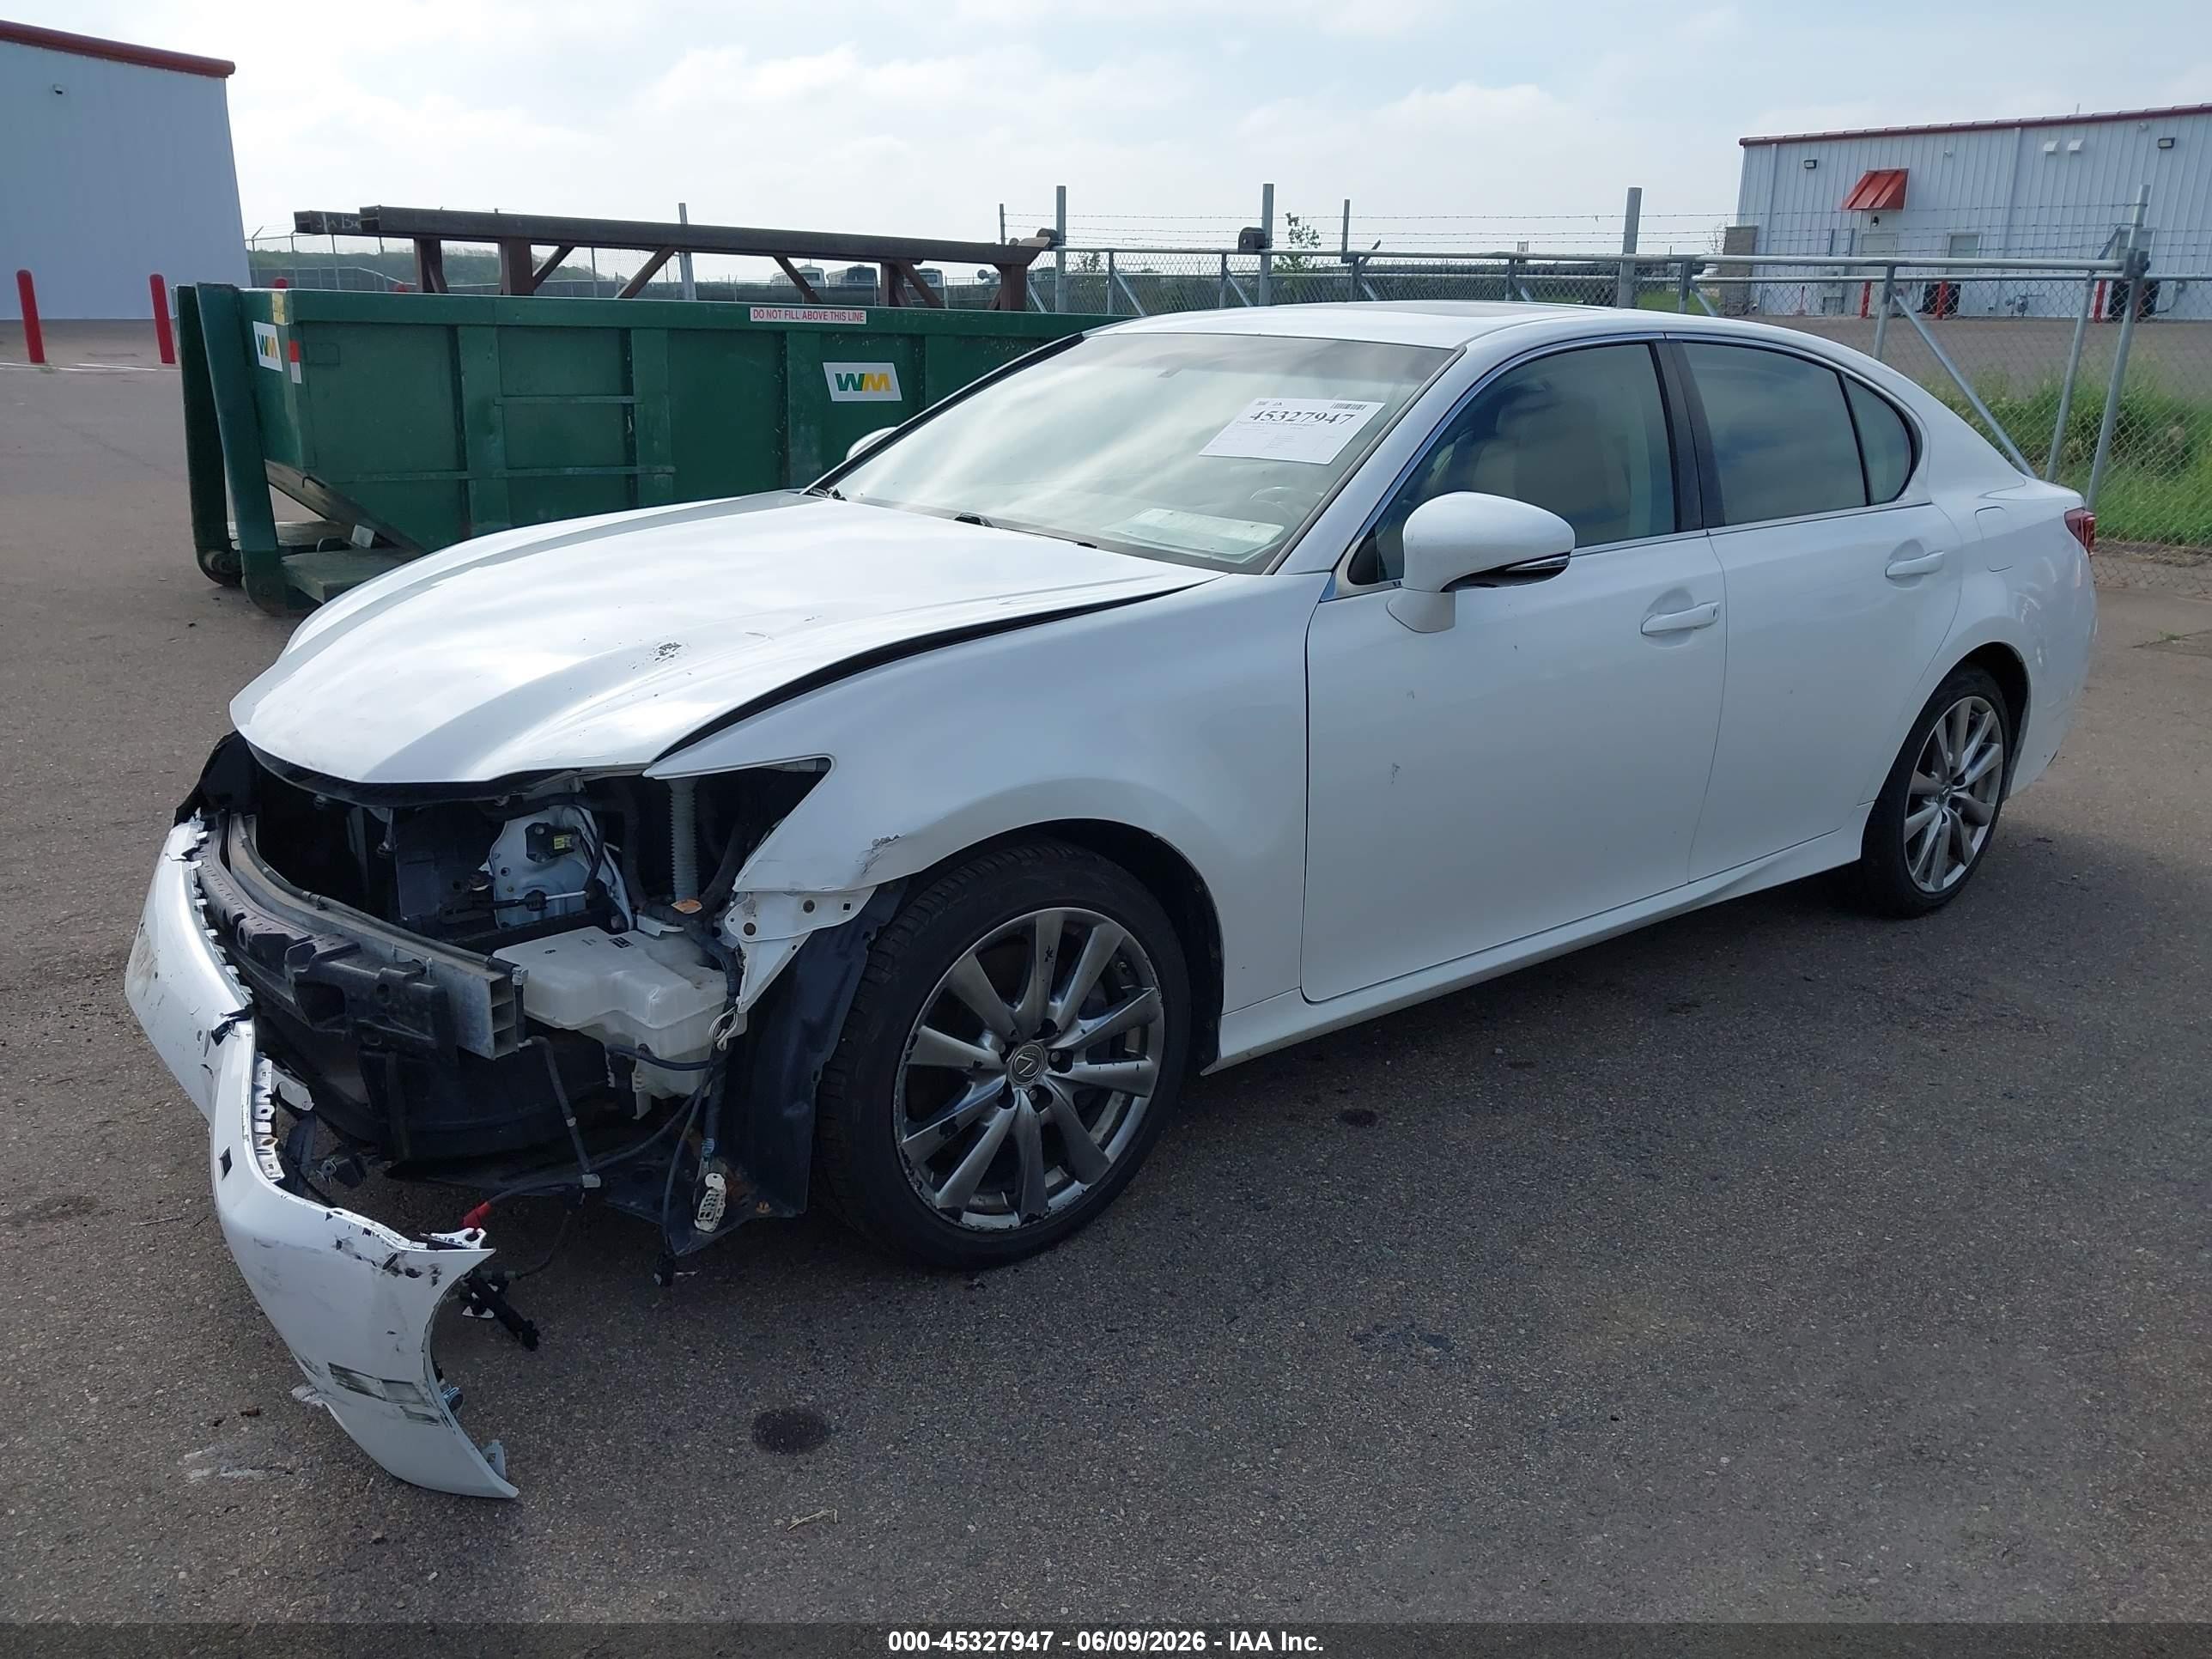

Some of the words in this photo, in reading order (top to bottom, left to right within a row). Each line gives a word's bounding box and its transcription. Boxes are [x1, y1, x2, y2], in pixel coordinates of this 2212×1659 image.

[753, 309, 764, 319] DO
[766, 309, 782, 319] NOT
[784, 310, 799, 320] FILL
[802, 310, 829, 321] ABOVE
[830, 311, 847, 322] THIS
[848, 312, 865, 322] LINE
[835, 373, 891, 392] WM
[1249, 410, 1356, 425] 45327947
